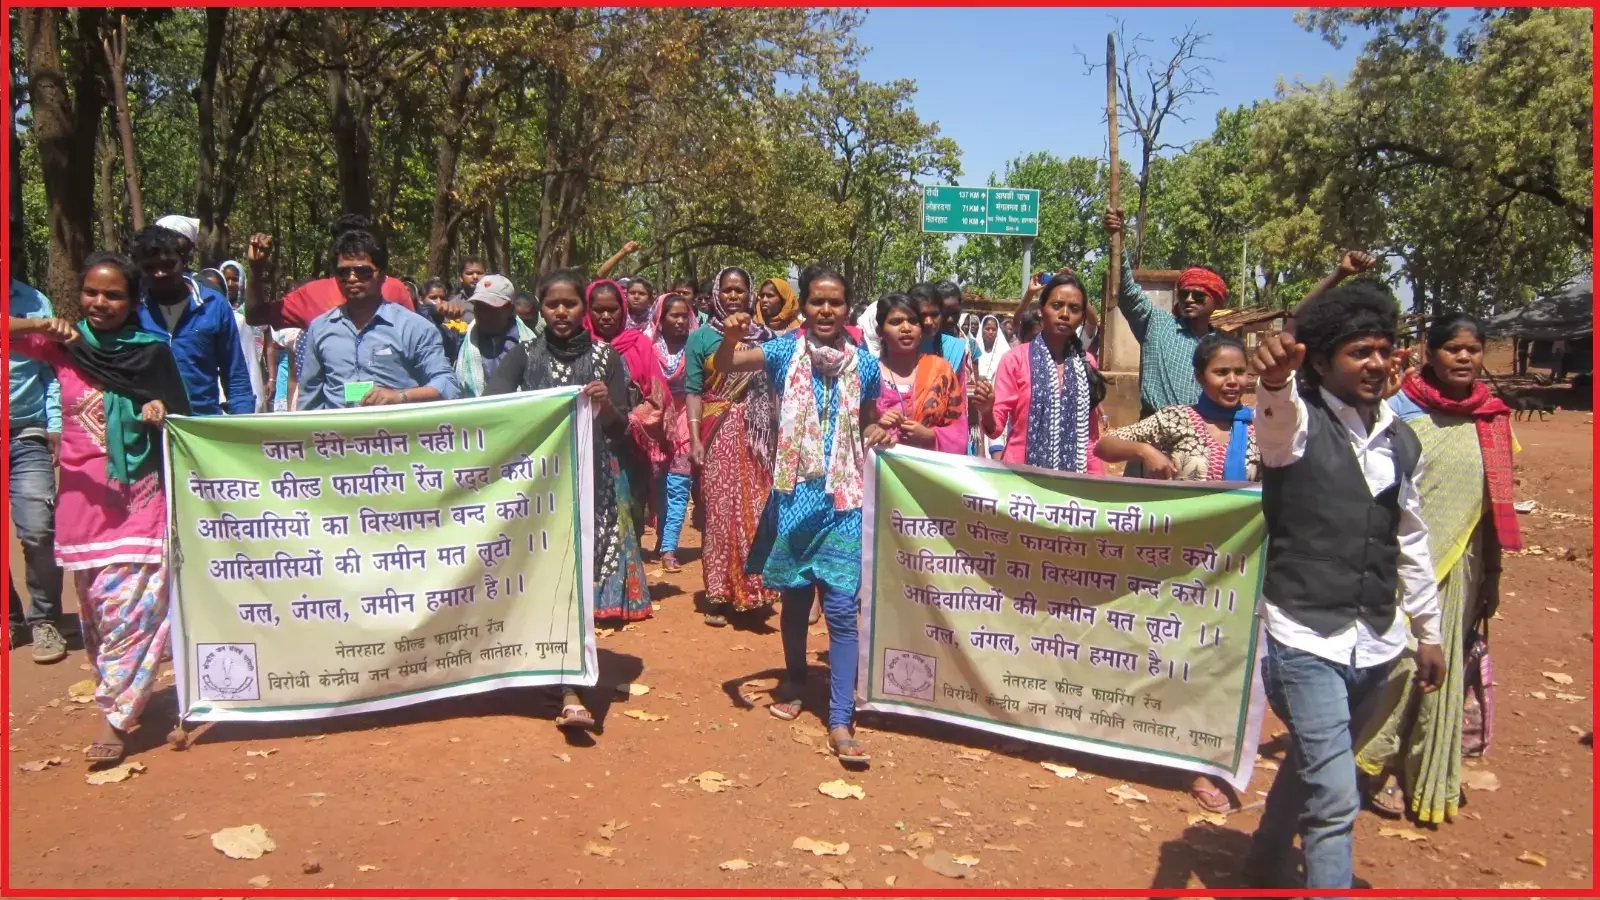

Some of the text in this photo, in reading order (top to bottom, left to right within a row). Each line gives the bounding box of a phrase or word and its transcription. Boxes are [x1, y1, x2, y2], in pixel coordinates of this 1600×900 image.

[263, 441, 304, 459] जान
[190, 472, 260, 500] नेतरहाट
[272, 472, 320, 498] फील्ड
[332, 466, 404, 494] फायरिंग
[413, 464, 443, 490] रेंज
[198, 511, 310, 539] आदिवासियों
[322, 516, 348, 534] का
[360, 508, 440, 533] विस्थापन
[451, 505, 486, 525] बन्द
[962, 494, 998, 515] जान
[892, 510, 956, 536] नेतरहाट
[967, 521, 1010, 544] फील्ड
[1019, 534, 1087, 557] फायरिंग
[1096, 539, 1124, 559] रेंज
[209, 550, 323, 579] आदिवासियों
[335, 548, 360, 574] की
[373, 545, 426, 570] जमीन
[438, 546, 466, 565] मत
[477, 534, 511, 567] लूटो
[896, 549, 996, 576] आदिवासियों
[1007, 560, 1030, 579] का
[1042, 561, 1116, 590] विस्थापन
[1127, 576, 1161, 598] बन्द
[239, 604, 280, 626] जल,
[292, 594, 349, 622] जंगल,
[362, 589, 414, 615] जमीन
[426, 586, 475, 611] हमारा
[903, 585, 1003, 612] आदिवासियों
[1014, 592, 1037, 615] की
[1047, 597, 1096, 625] जमीन
[1107, 610, 1135, 631] मत
[1146, 613, 1182, 644] लूटो
[336, 619, 504, 658] नेतरहाट फील्ड फायरिंग रेंज
[926, 624, 958, 648] जल,
[971, 626, 1019, 655] जंगल,
[1032, 634, 1080, 660] जमीन
[1090, 646, 1138, 671] हमारा
[268, 642, 568, 690] विरोधी केन्द्रीय जन संघर्ष समिति लातेहार, गुमला
[1003, 671, 1162, 710] नेतरहाट फील्ड फायरिंग रेंज
[943, 683, 1222, 748] विरोधी केन्द्रीय जन संघर्ष समिति लातेहार, गुमला
